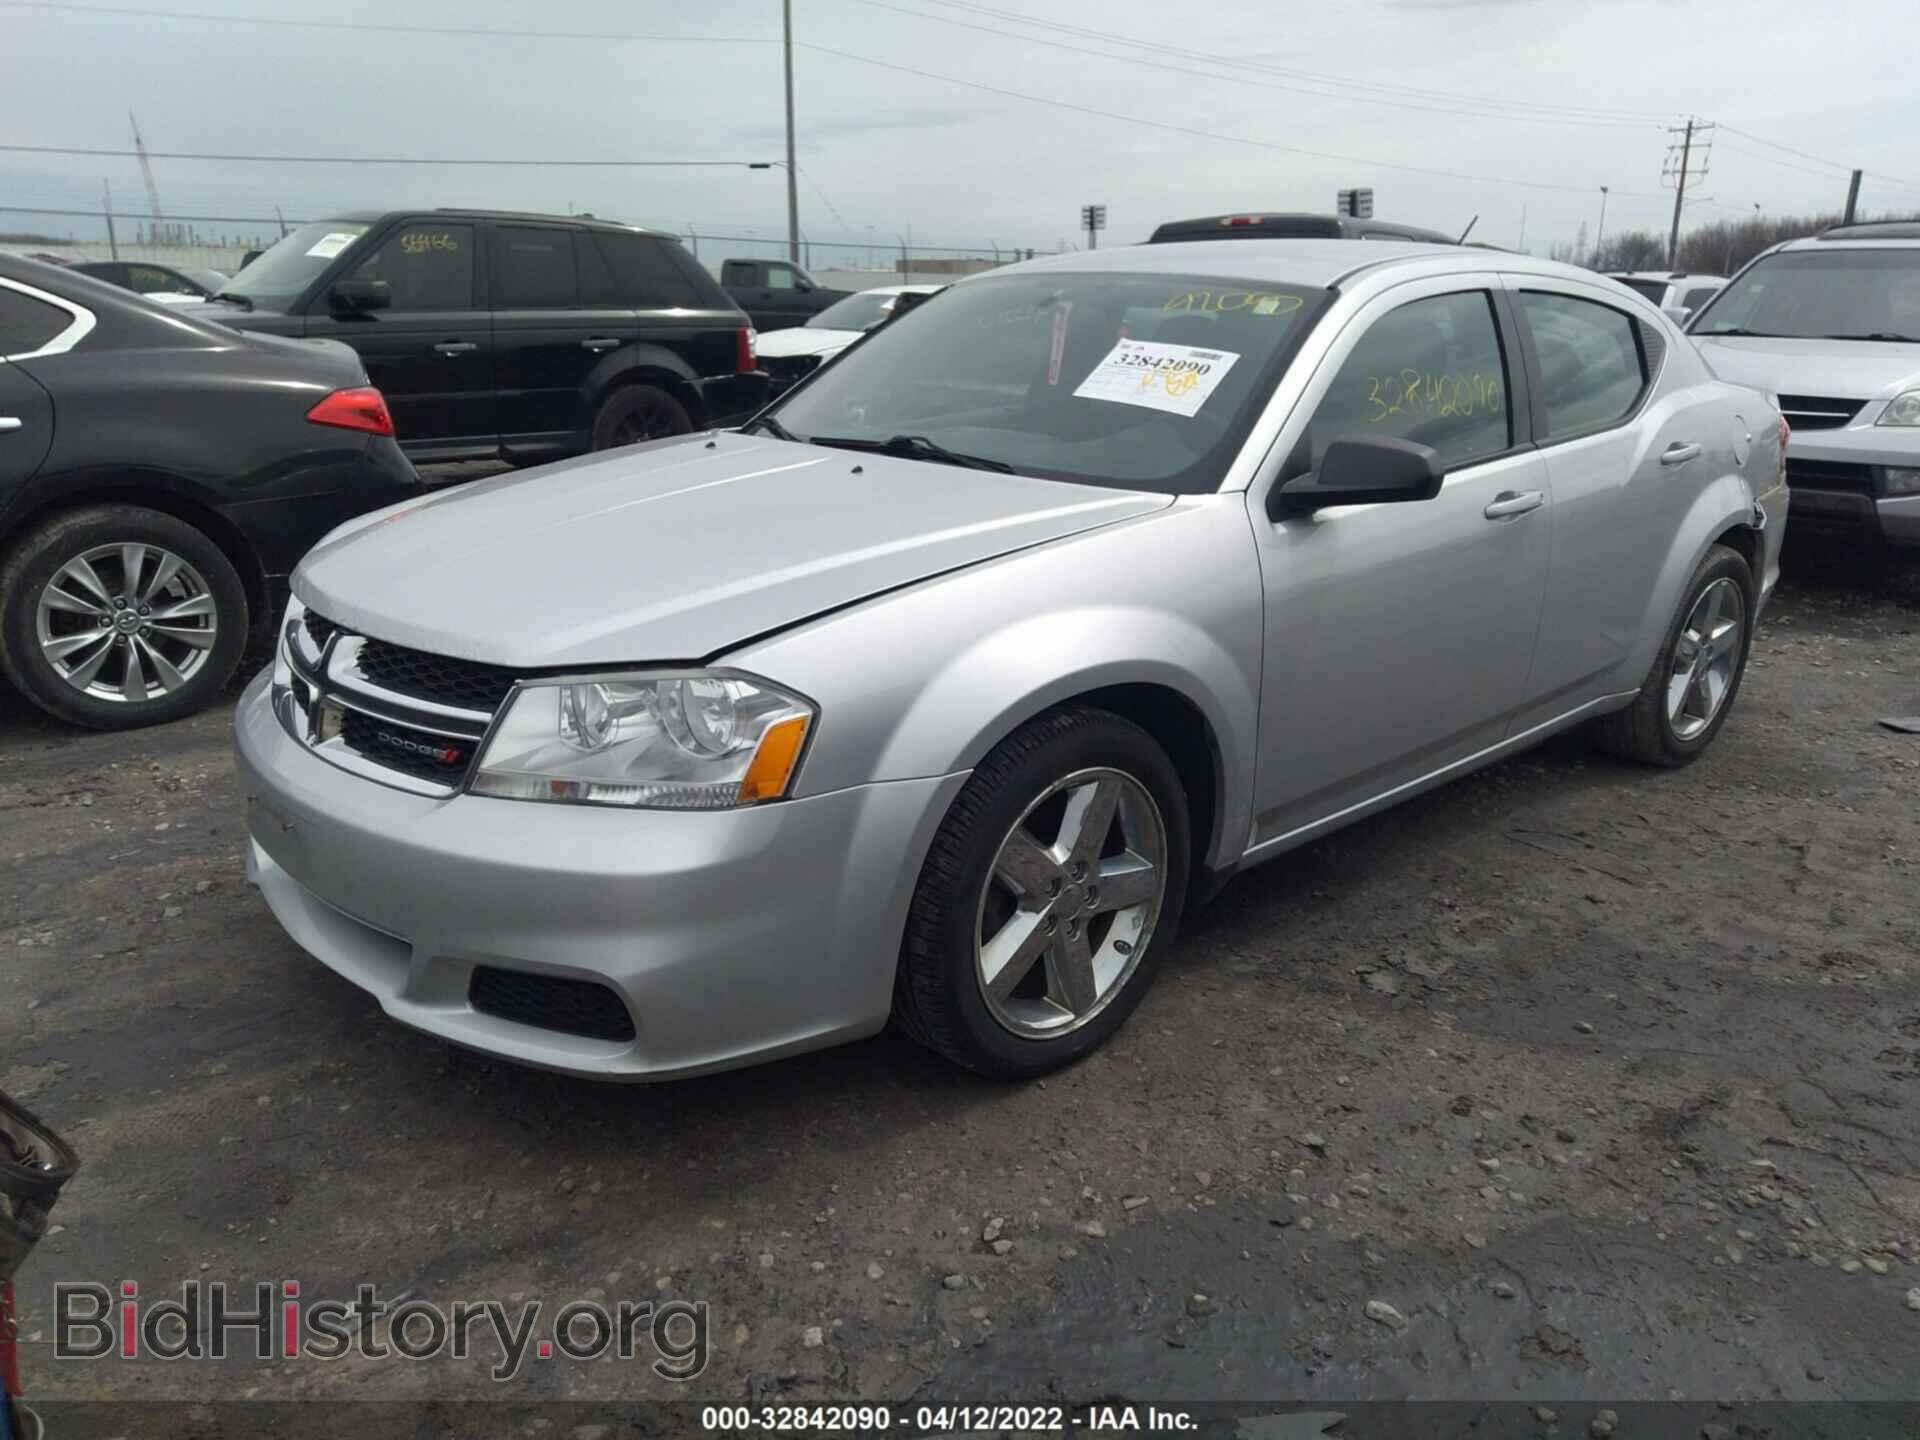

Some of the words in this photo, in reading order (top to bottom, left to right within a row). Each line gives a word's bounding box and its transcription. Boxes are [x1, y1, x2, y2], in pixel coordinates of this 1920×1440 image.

[1113, 353, 1211, 376] 32842090
[1368, 367, 1500, 422] 32842090
[378, 731, 444, 758] DODGE
